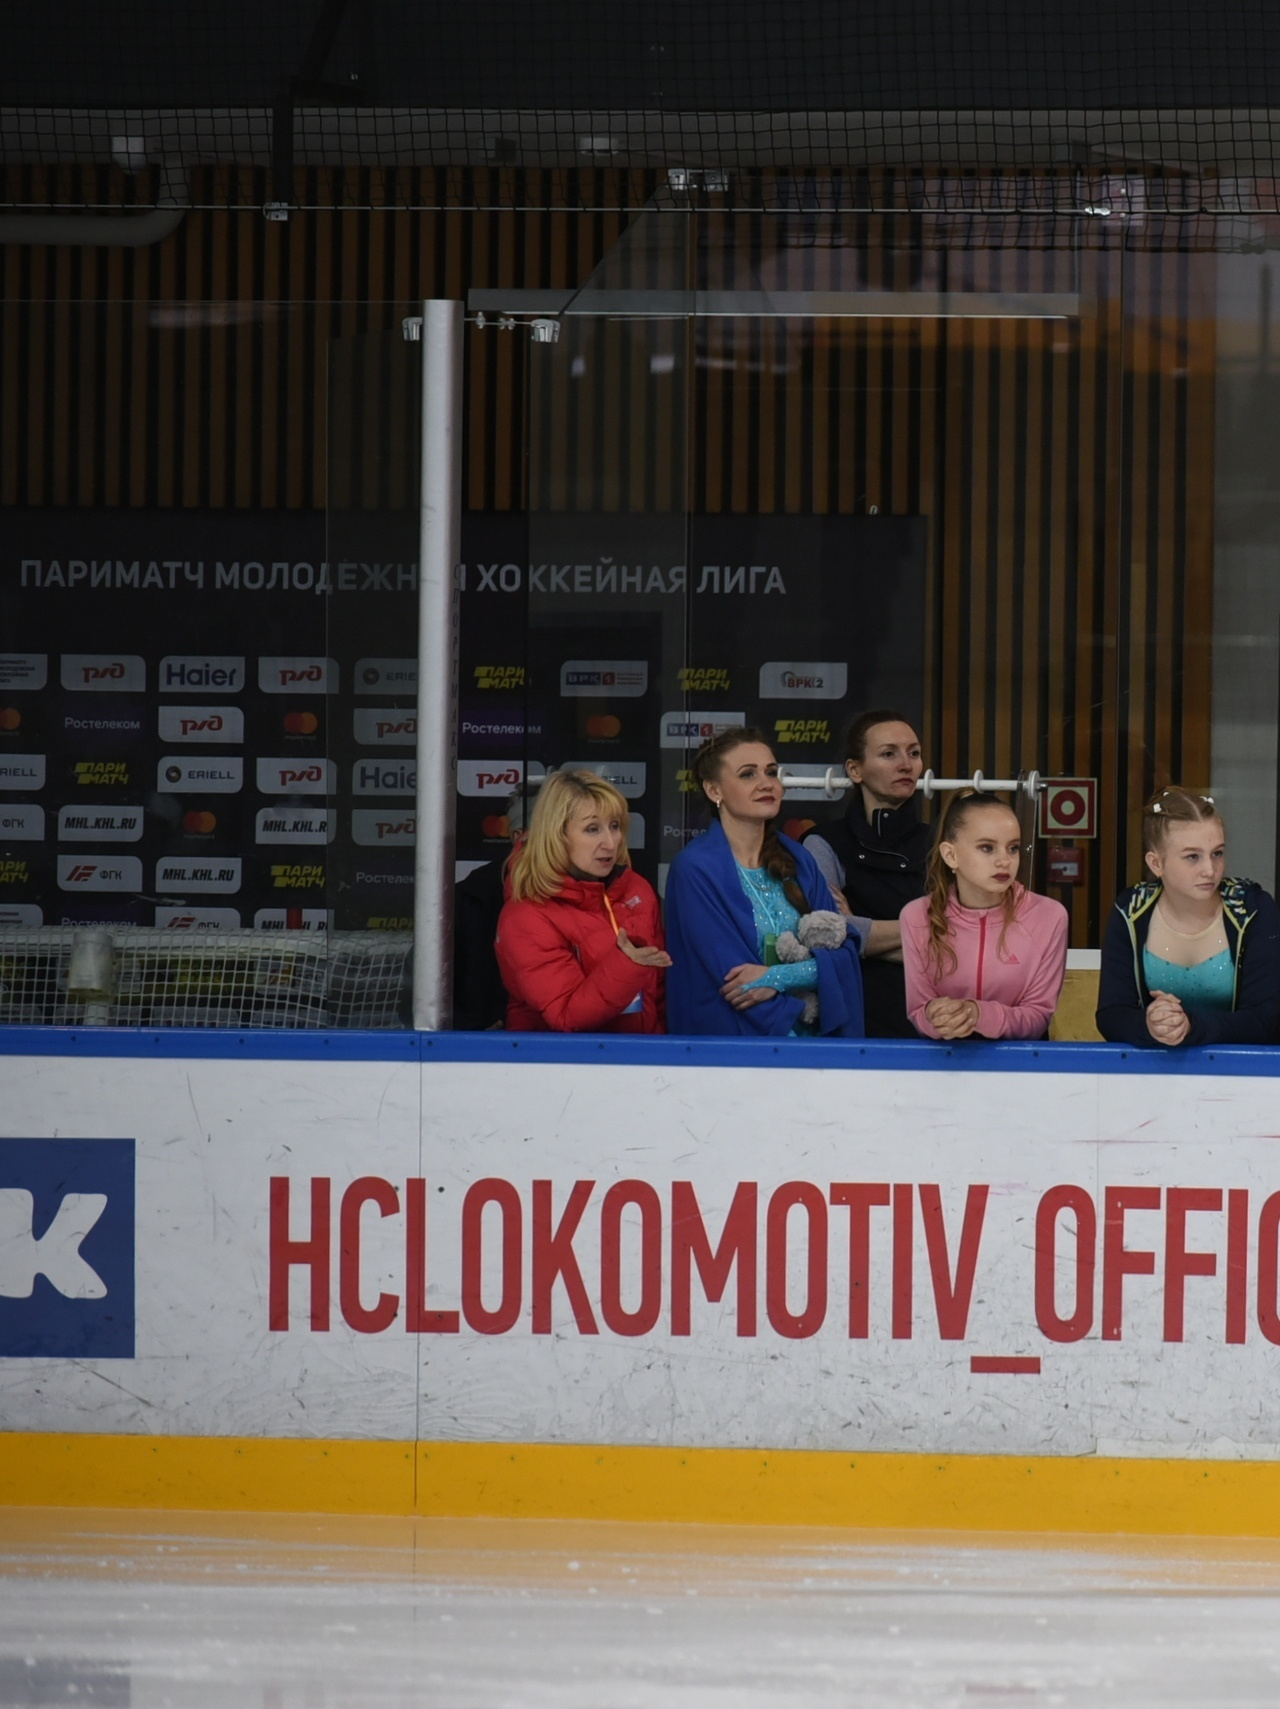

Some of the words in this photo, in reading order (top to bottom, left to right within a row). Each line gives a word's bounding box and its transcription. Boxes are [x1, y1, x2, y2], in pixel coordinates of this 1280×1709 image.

[21, 560, 204, 589] ПАРИМАТЧ
[215, 562, 466, 595] МОЛОДЕЖН
[476, 557, 687, 594] ХОККЕЙНАЯ
[696, 565, 787, 594] ЛИГА
[166, 663, 236, 686] Haier
[385, 671, 417, 681] ERIE
[677, 668, 728, 679] ПАРИ
[680, 679, 731, 691] МАТЧ
[64, 718, 140, 730] Ростелеком
[774, 719, 829, 731] ПАРИ
[777, 731, 832, 743] МАТЧ
[0, 768, 38, 778] RIELL
[75, 762, 127, 773] ПАРИ
[78, 773, 129, 785] МАТЧ
[188, 770, 235, 780] ERIELL
[360, 766, 417, 789] Haie
[2, 818, 25, 829] ФГК
[64, 817, 137, 830] MHL.KHL.RU
[262, 819, 328, 833] MHL.KHL.R
[0, 861, 26, 872] АРИ
[270, 865, 323, 876] ПАРИ
[0, 871, 29, 883] АТЧ
[100, 870, 123, 880] ФГК
[162, 868, 235, 882] MHL.KHL.RU
[356, 871, 416, 884] Ростелек
[273, 876, 326, 888] МАТЧ
